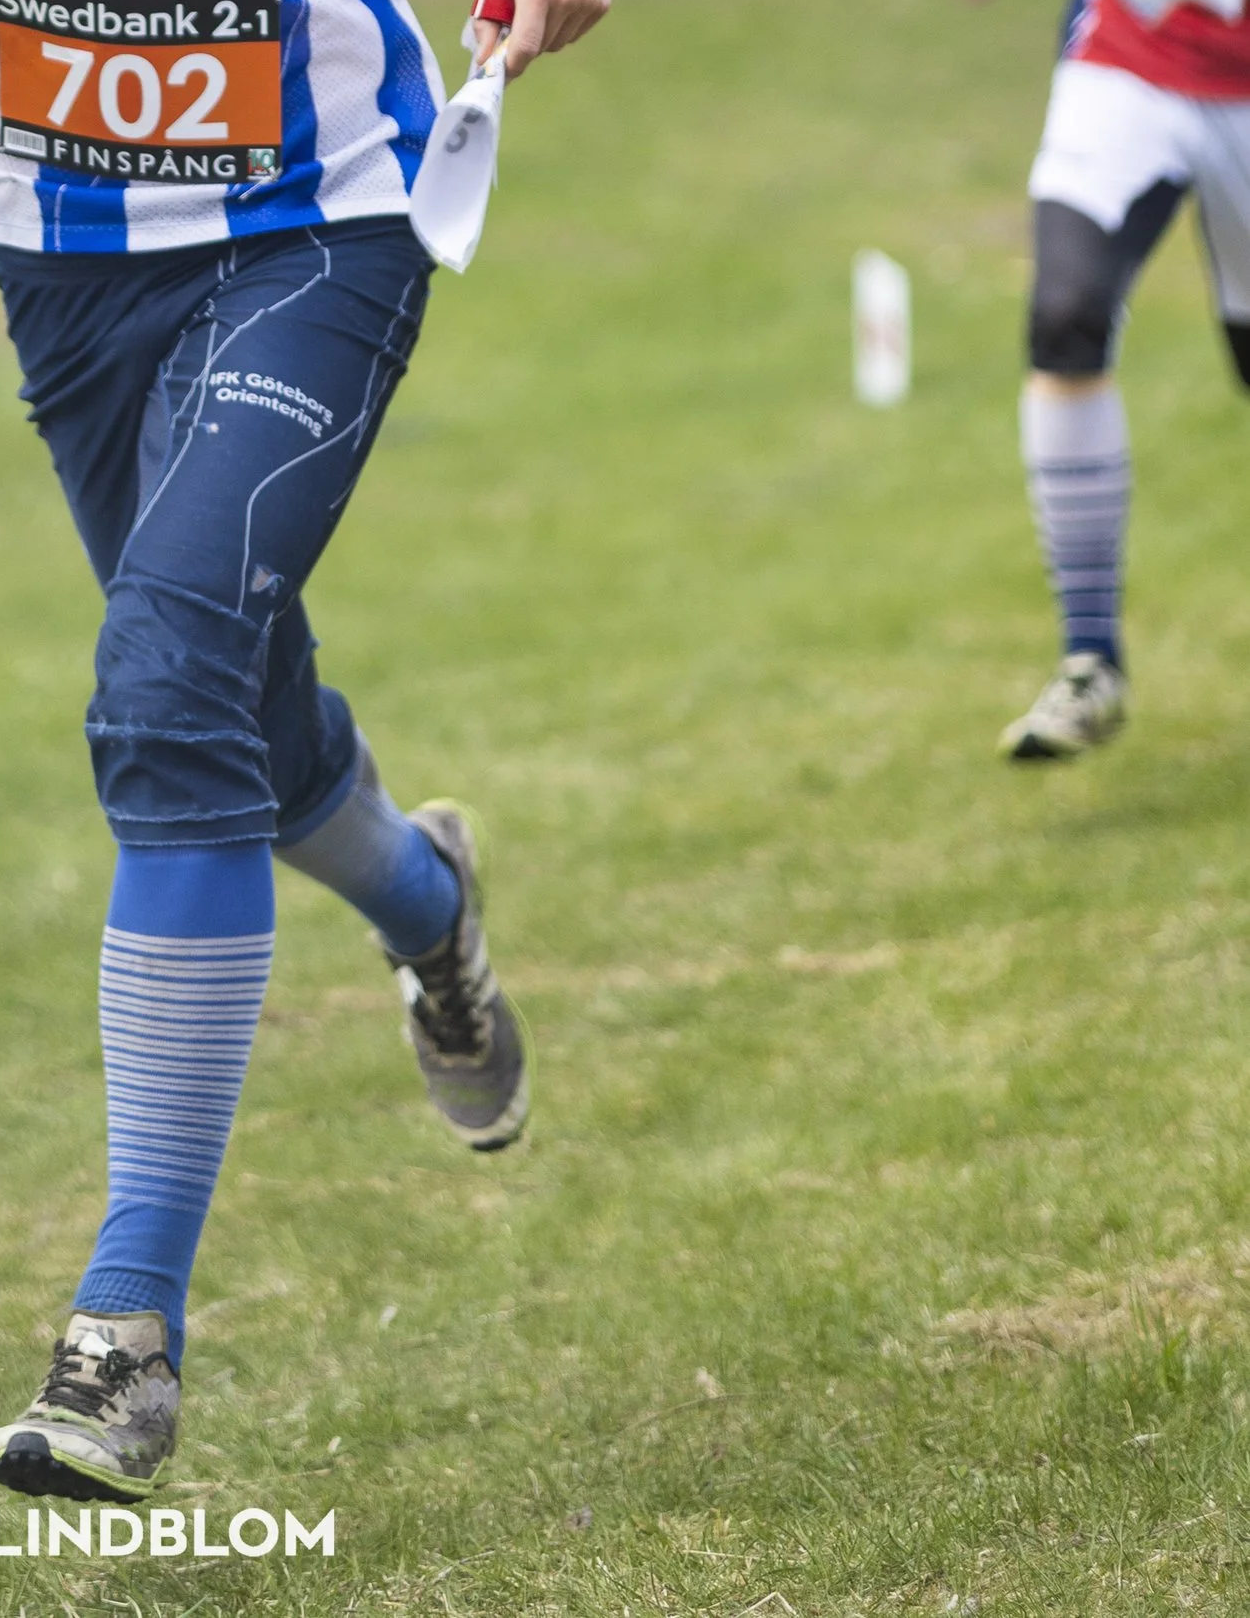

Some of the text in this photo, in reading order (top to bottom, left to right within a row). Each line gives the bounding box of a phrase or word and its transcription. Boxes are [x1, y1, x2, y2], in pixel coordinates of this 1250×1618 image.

[211, 0, 269, 38] 2-1
[41, 41, 229, 139] 702
[54, 138, 237, 177] FINSPÅNG
[209, 370, 334, 425] IFK Göteborg
[215, 387, 323, 438] Orientering
